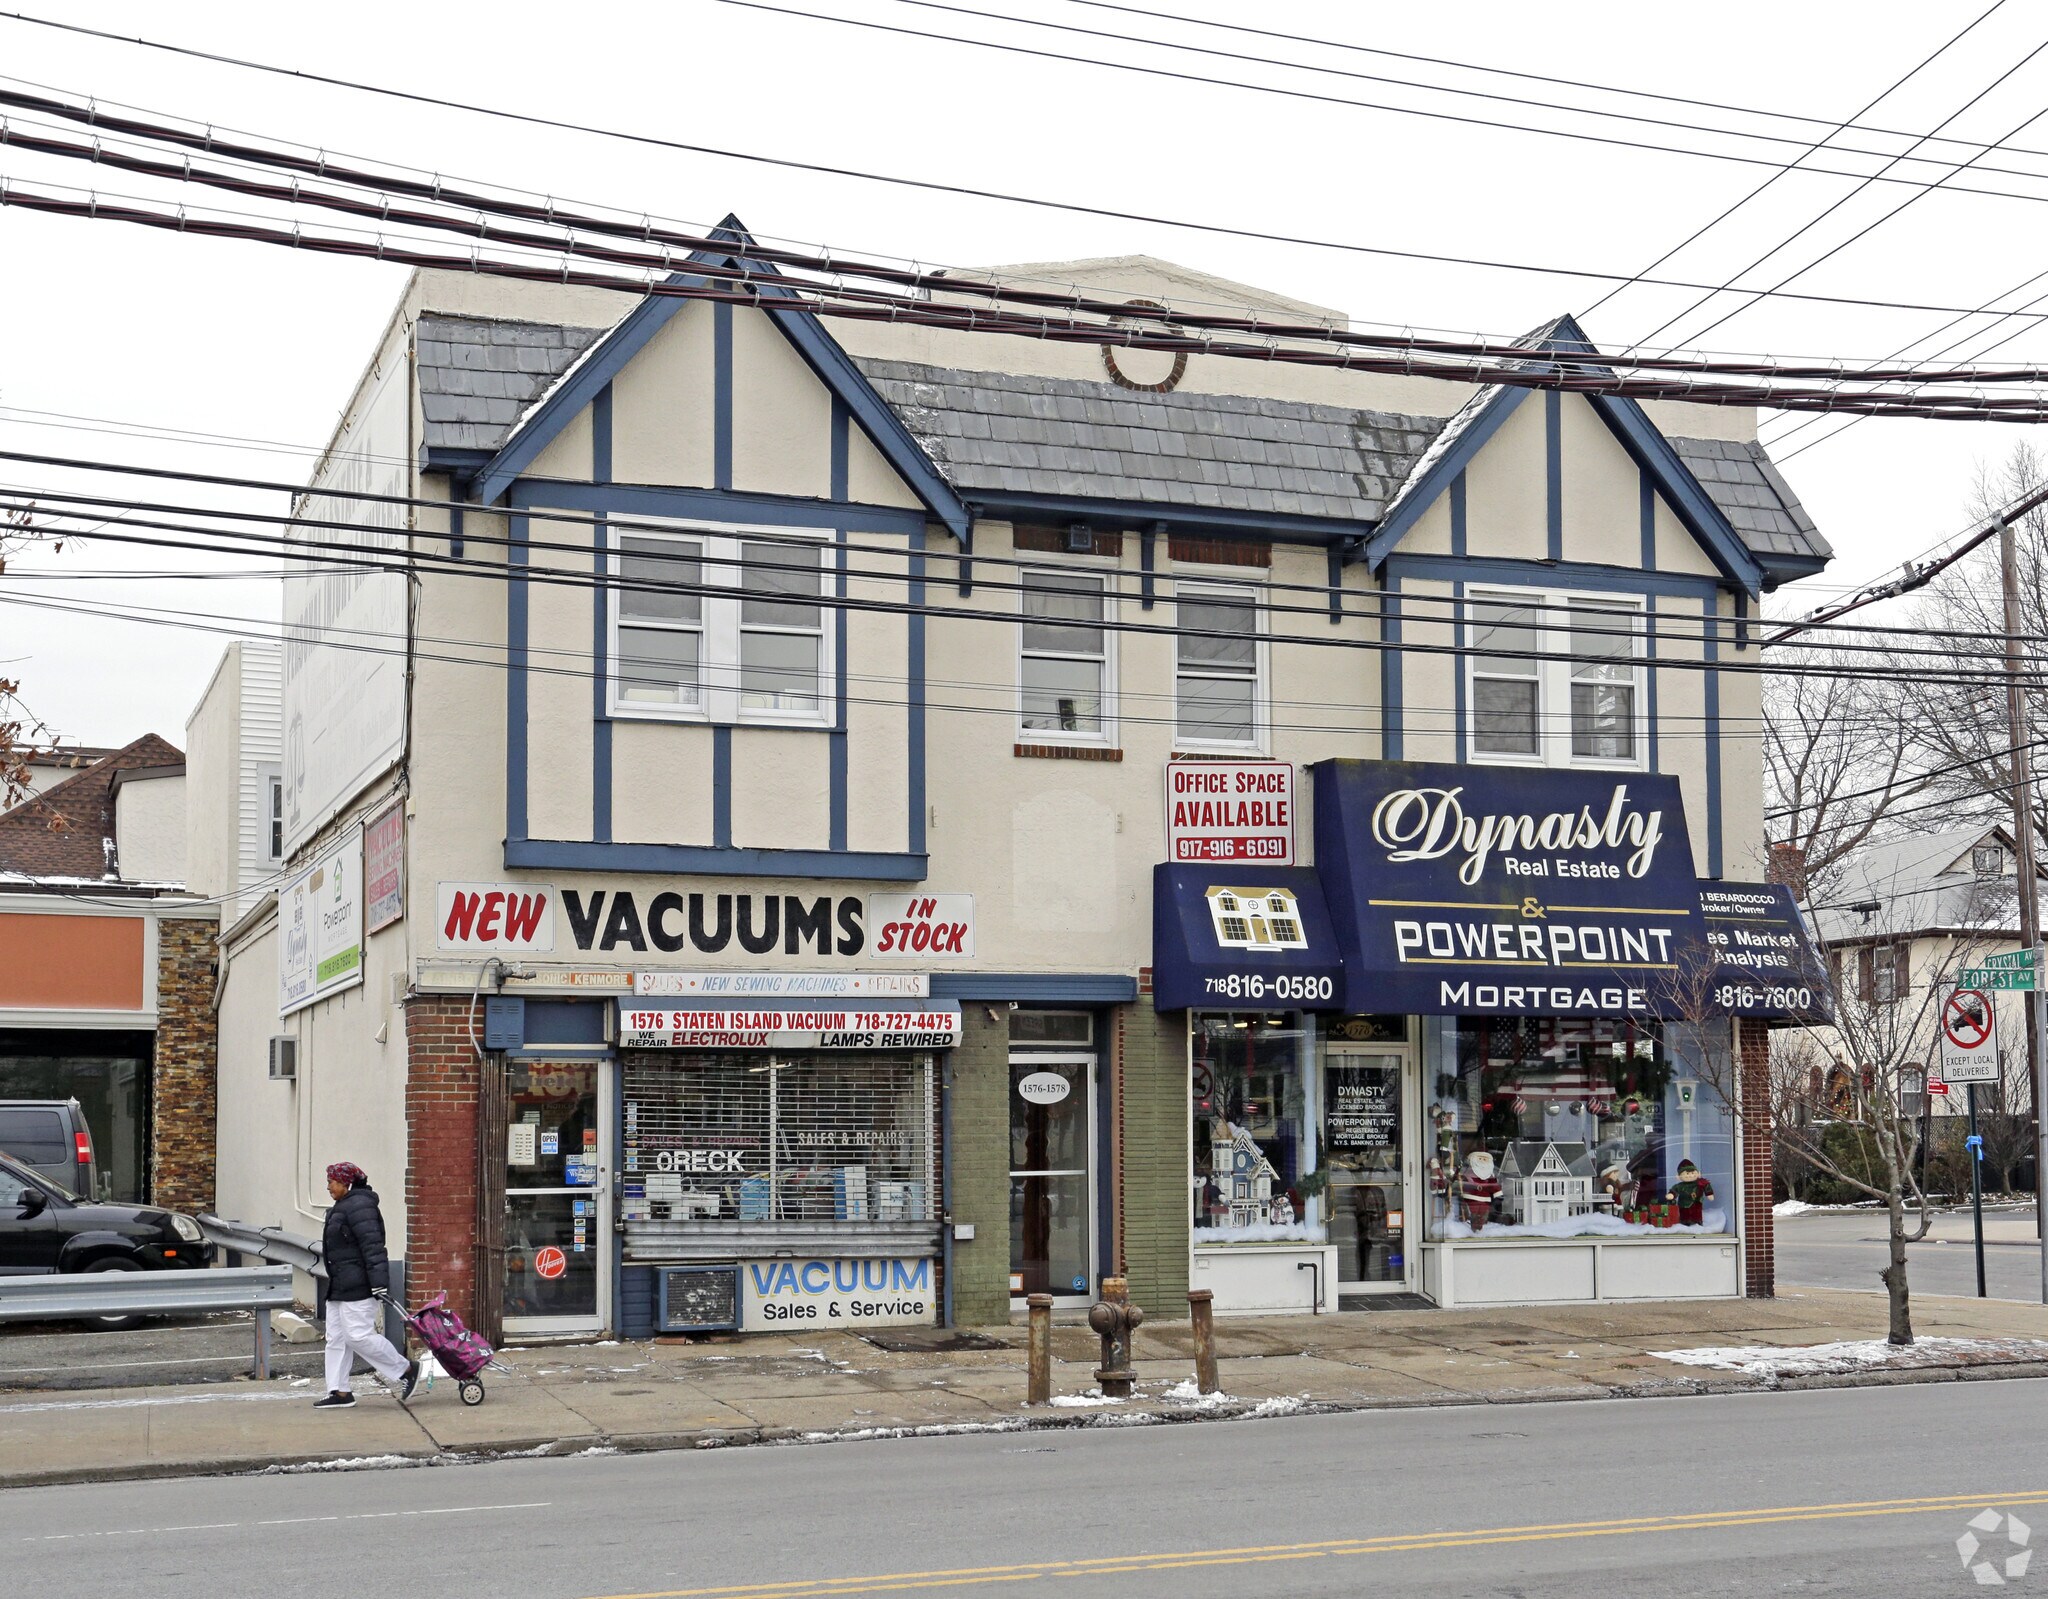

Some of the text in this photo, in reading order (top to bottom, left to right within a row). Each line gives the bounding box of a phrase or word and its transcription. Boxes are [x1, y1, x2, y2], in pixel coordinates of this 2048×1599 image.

[1174, 771, 1286, 793] OFFICE SPACE
[1174, 801, 1288, 827] AVAILABLE
[1372, 784, 1662, 886] Dynasty
[1505, 858, 1620, 879] Real Estate
[1521, 897, 1547, 918] &
[1707, 893, 1775, 904] BERARDOCCO
[444, 890, 547, 942] NEW
[906, 898, 937, 919] IN
[561, 889, 864, 955] VACUUMS
[877, 921, 967, 954] STOCK
[1394, 920, 1673, 966] POWERPOINT
[1734, 930, 1799, 948] Market
[1714, 950, 1788, 968] Analysis
[2025, 952, 2033, 960] AV
[574, 973, 628, 985] KENMORE
[702, 976, 729, 992] NEW
[734, 976, 782, 992] SEWING
[787, 977, 847, 992] MACHINES
[1963, 971, 2014, 987] FOREST
[1441, 980, 1646, 1009] MORTGAGE
[630, 1012, 953, 1030] 1576 STATEN ISLAND VACUUM 718-727-4475
[628, 1039, 668, 1047] REPAIR
[671, 1032, 768, 1046] ELECTROLUX
[820, 1033, 954, 1047] LAMPS REWIRED
[1947, 1056, 1994, 1066] EXCEPT LOCAL
[1953, 1067, 1990, 1077] DELIVERIES
[1023, 1084, 1066, 1093] 1576-1578
[1338, 1086, 1386, 1096] DYNASTY
[542, 1135, 558, 1143] OPEN
[642, 1136, 760, 1147] SALES & REPAIRS
[799, 1132, 905, 1145] SALES & REPAIRS
[657, 1150, 746, 1172] ORECK
[750, 1259, 929, 1298] VACUUM
[763, 1297, 924, 1320] Sales & Service
